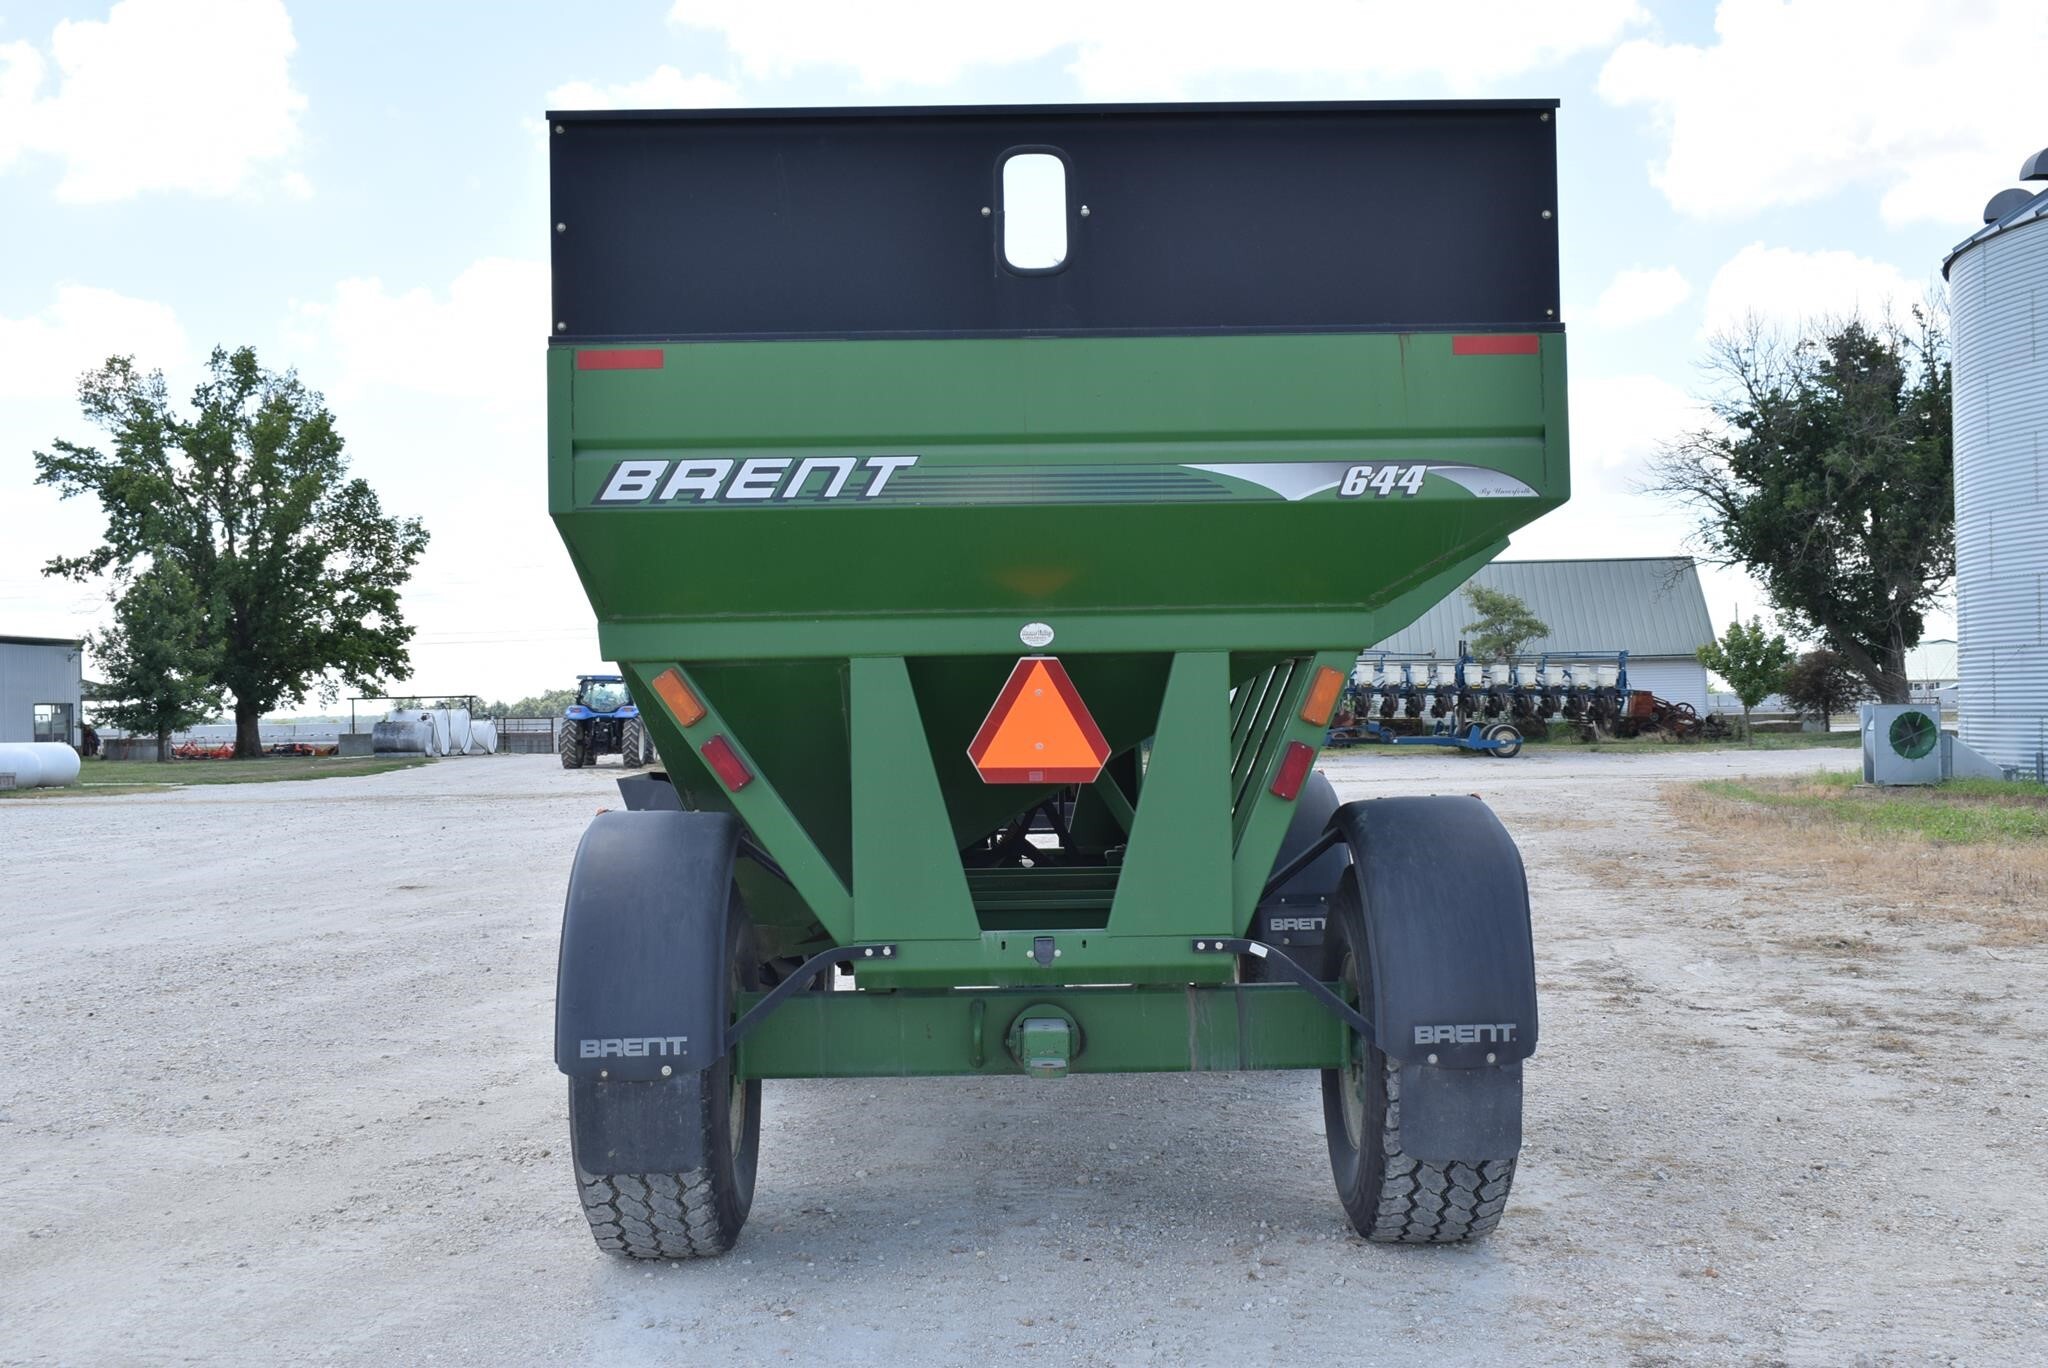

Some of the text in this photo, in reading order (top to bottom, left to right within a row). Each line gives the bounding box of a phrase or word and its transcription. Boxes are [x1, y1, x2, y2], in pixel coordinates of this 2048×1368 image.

[599, 455, 920, 502] BRENT
[1340, 464, 1427, 496] 644
[1270, 917, 1327, 931] BREN
[1414, 1023, 1516, 1045] BRENT
[580, 1036, 687, 1058] BRENT
